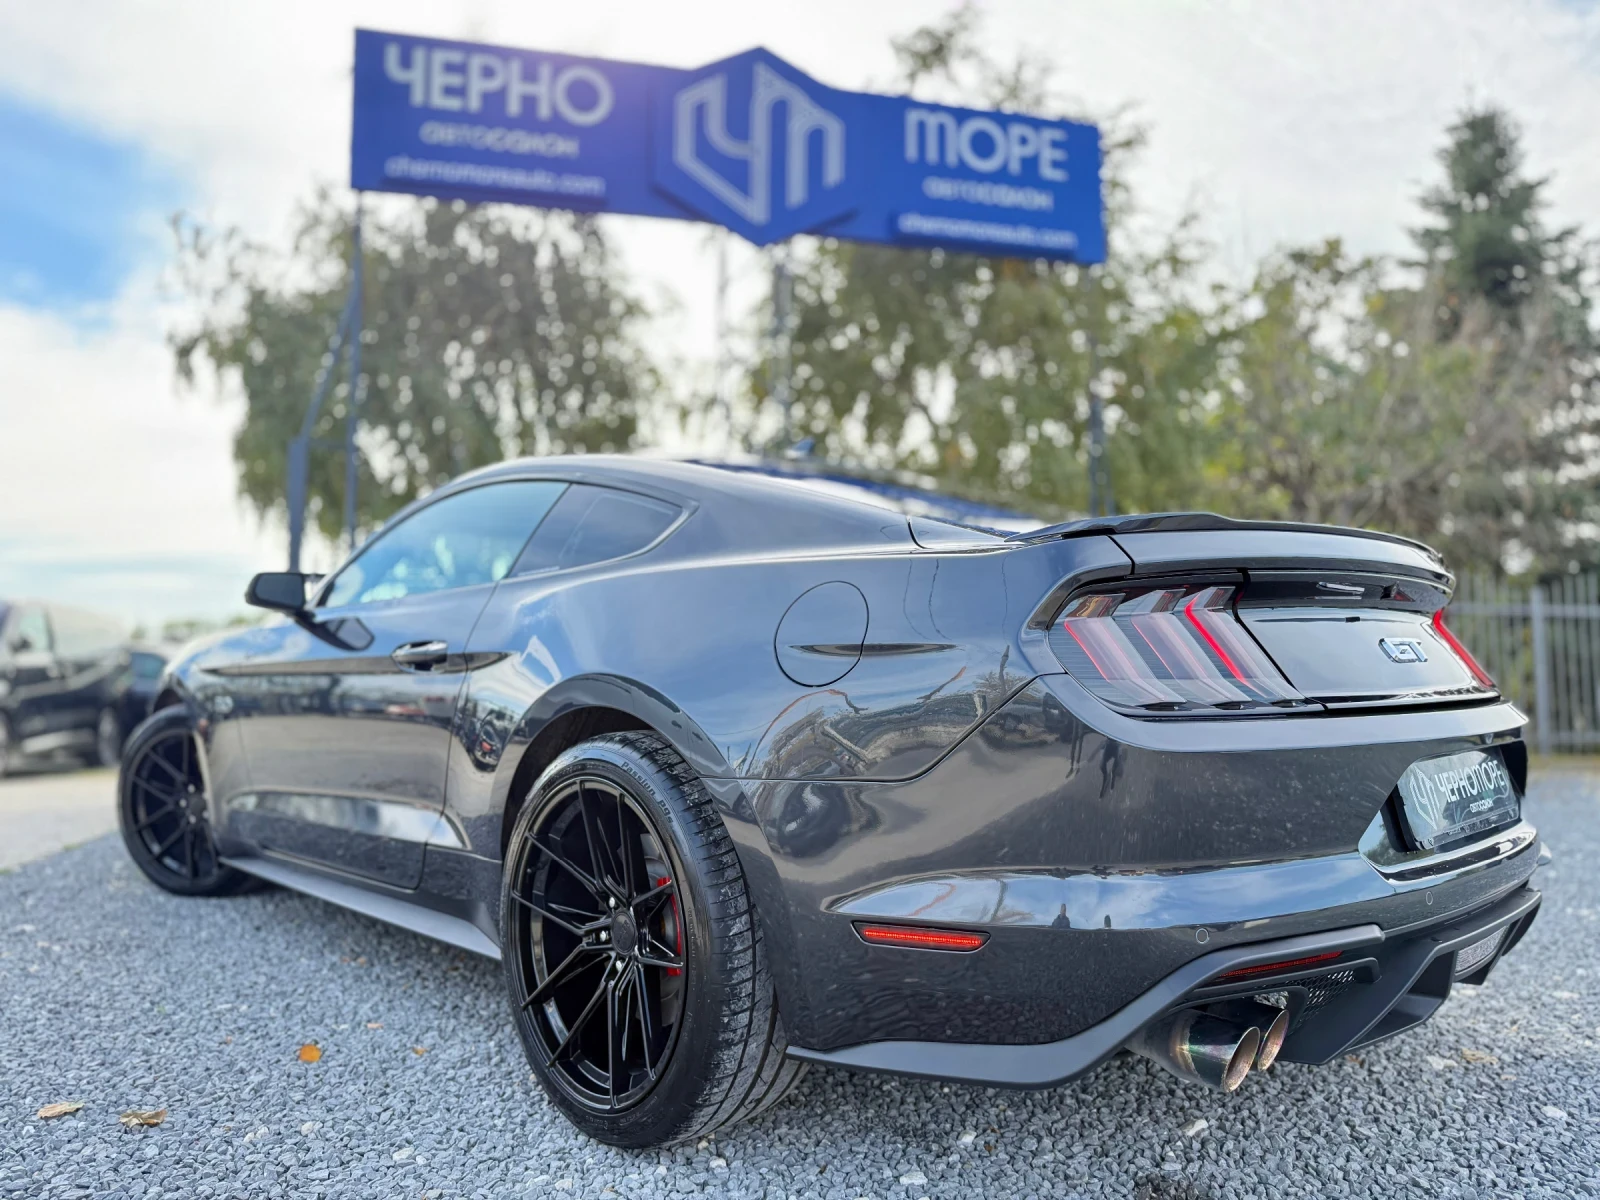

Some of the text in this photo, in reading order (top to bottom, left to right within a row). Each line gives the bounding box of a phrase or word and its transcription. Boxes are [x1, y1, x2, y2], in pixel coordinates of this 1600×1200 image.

[382, 42, 615, 127] ЧЕРНО
[904, 108, 1069, 182] МОРЕ
[1379, 637, 1428, 664] GT
[1435, 760, 1505, 802] ЧЕРНОМОРЕ
